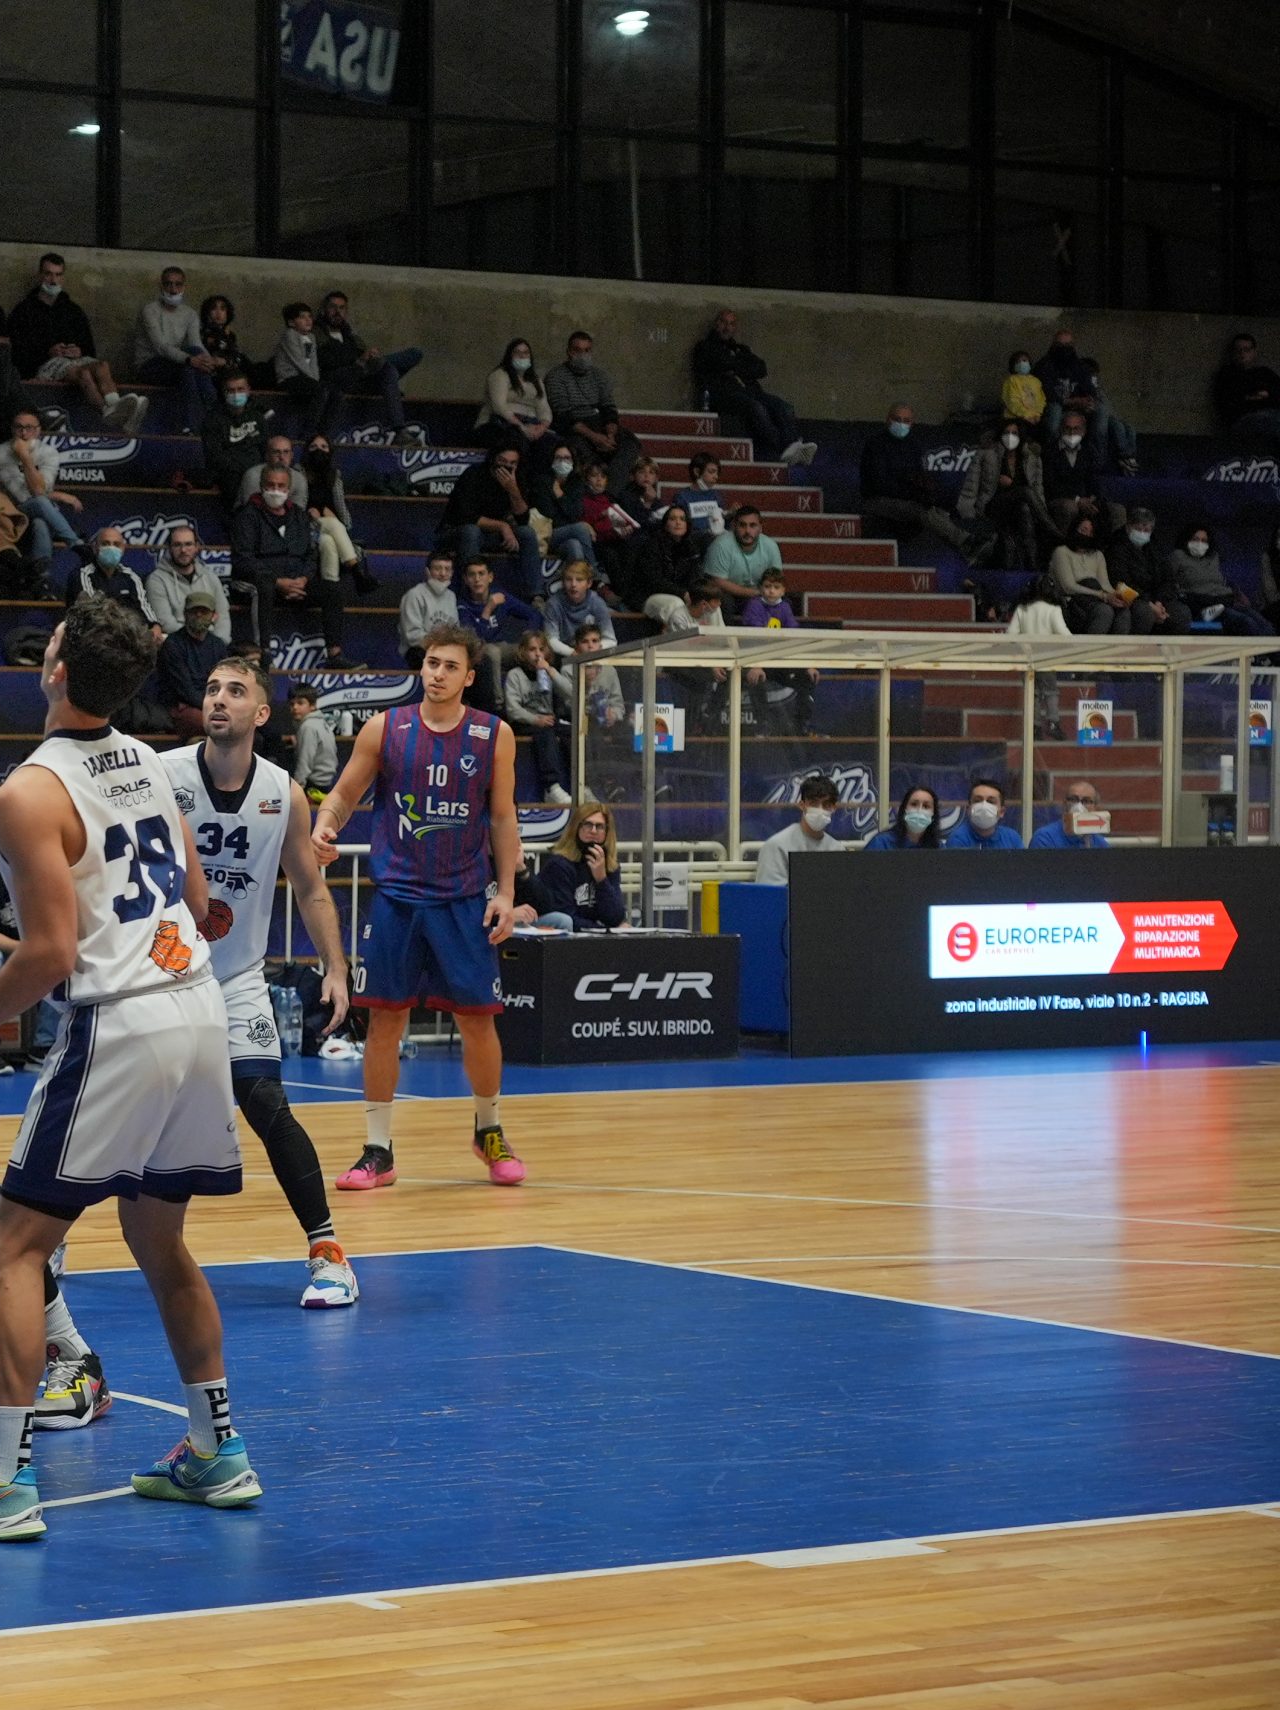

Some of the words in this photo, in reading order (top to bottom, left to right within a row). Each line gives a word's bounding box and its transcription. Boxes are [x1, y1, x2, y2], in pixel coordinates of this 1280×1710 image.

[343, 690, 369, 700] KLEB
[1082, 702, 1109, 711] molten
[1250, 702, 1268, 710] olten
[426, 764, 448, 787] 10
[104, 778, 152, 799] LEXUS
[426, 796, 470, 817] Lars
[427, 816, 468, 825] Riabilitazione
[196, 823, 250, 859] 34
[1134, 914, 1215, 927] MANUTENZIONE
[985, 927, 1099, 945] EUROREPAR
[1134, 930, 1200, 943] RIPARAZIONE
[1134, 946, 1201, 959] MULTIMARCA
[574, 971, 714, 1001] C-HR
[502, 994, 535, 1009] -HR
[945, 1000, 976, 1013] zona
[978, 997, 1037, 1012] industriale
[1039, 995, 1052, 1010] IV
[1054, 995, 1084, 1011] Fase,
[1086, 994, 1114, 1009] viale
[1117, 993, 1131, 1007] 10
[1160, 991, 1209, 1006] RAGUSA
[572, 1018, 625, 1038] COUPÉ.
[627, 1020, 660, 1037] SUV.
[663, 1019, 714, 1035] IBRIDO.
